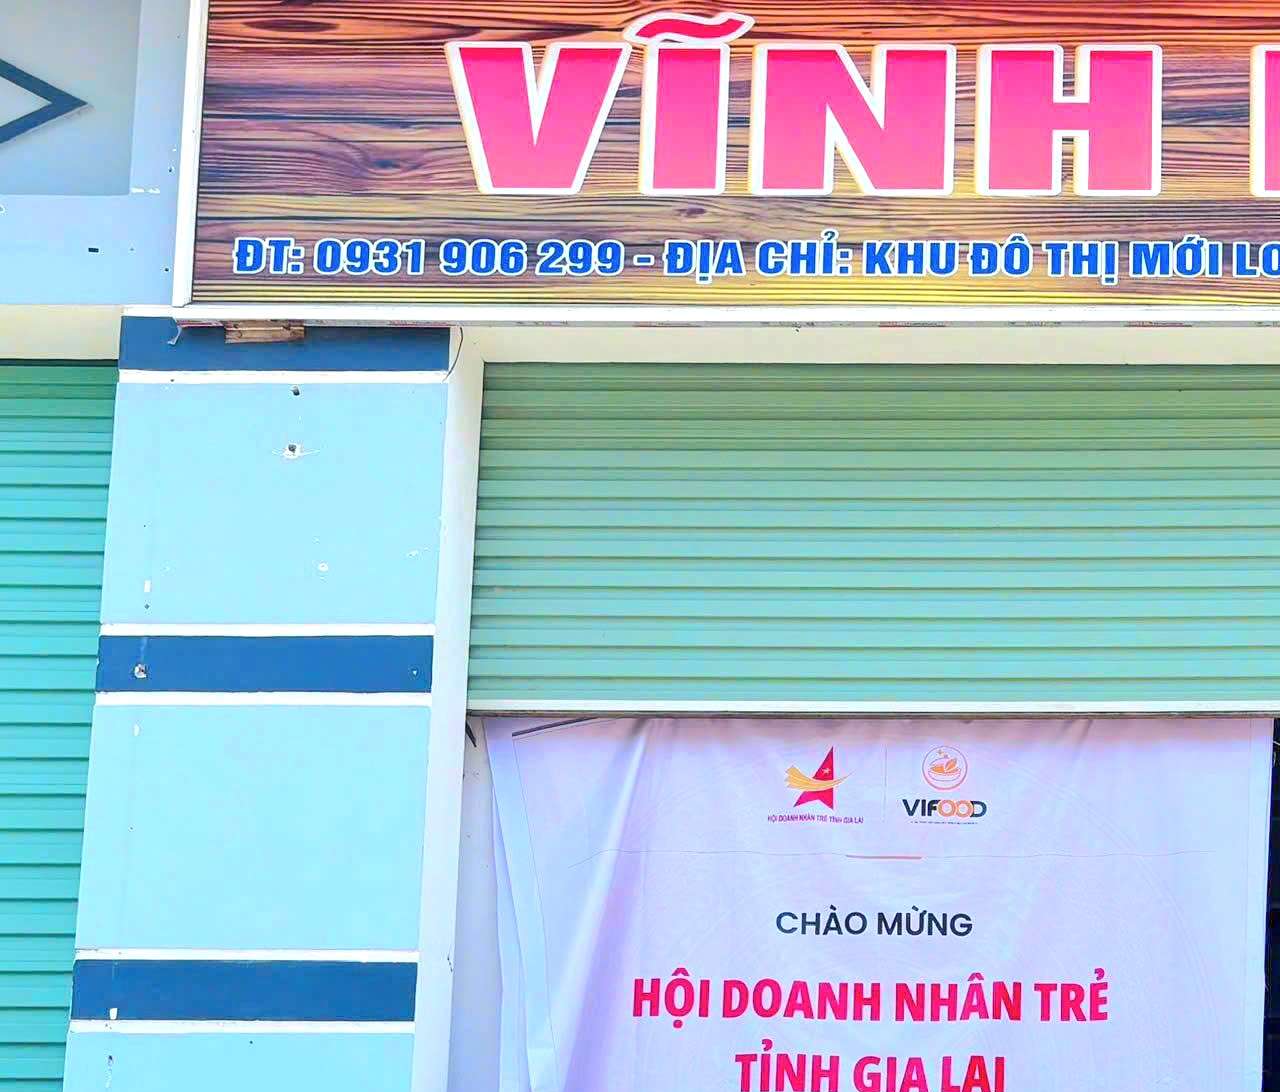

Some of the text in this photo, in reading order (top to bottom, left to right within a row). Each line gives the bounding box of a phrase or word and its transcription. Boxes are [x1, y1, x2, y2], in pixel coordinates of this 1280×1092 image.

[443, 12, 1163, 197] VĨNH
[234, 237, 304, 274] ĐT:
[313, 239, 425, 275] 0931
[439, 239, 527, 276] 906
[536, 239, 625, 276] 299
[663, 238, 745, 283] ĐỊA
[756, 229, 853, 276] CHỈ:
[864, 239, 957, 276] KHU
[968, 233, 1033, 276] ĐÔ
[1043, 240, 1118, 285] THỊ
[1131, 234, 1220, 278] MỚI
[902, 799, 987, 818] VIFOOD
[775, 905, 973, 936] CHÀO MỪNG
[632, 967, 1108, 1028] HỘI DOANH NHÂN TRẺ
[735, 1038, 839, 1092] TỈNH
